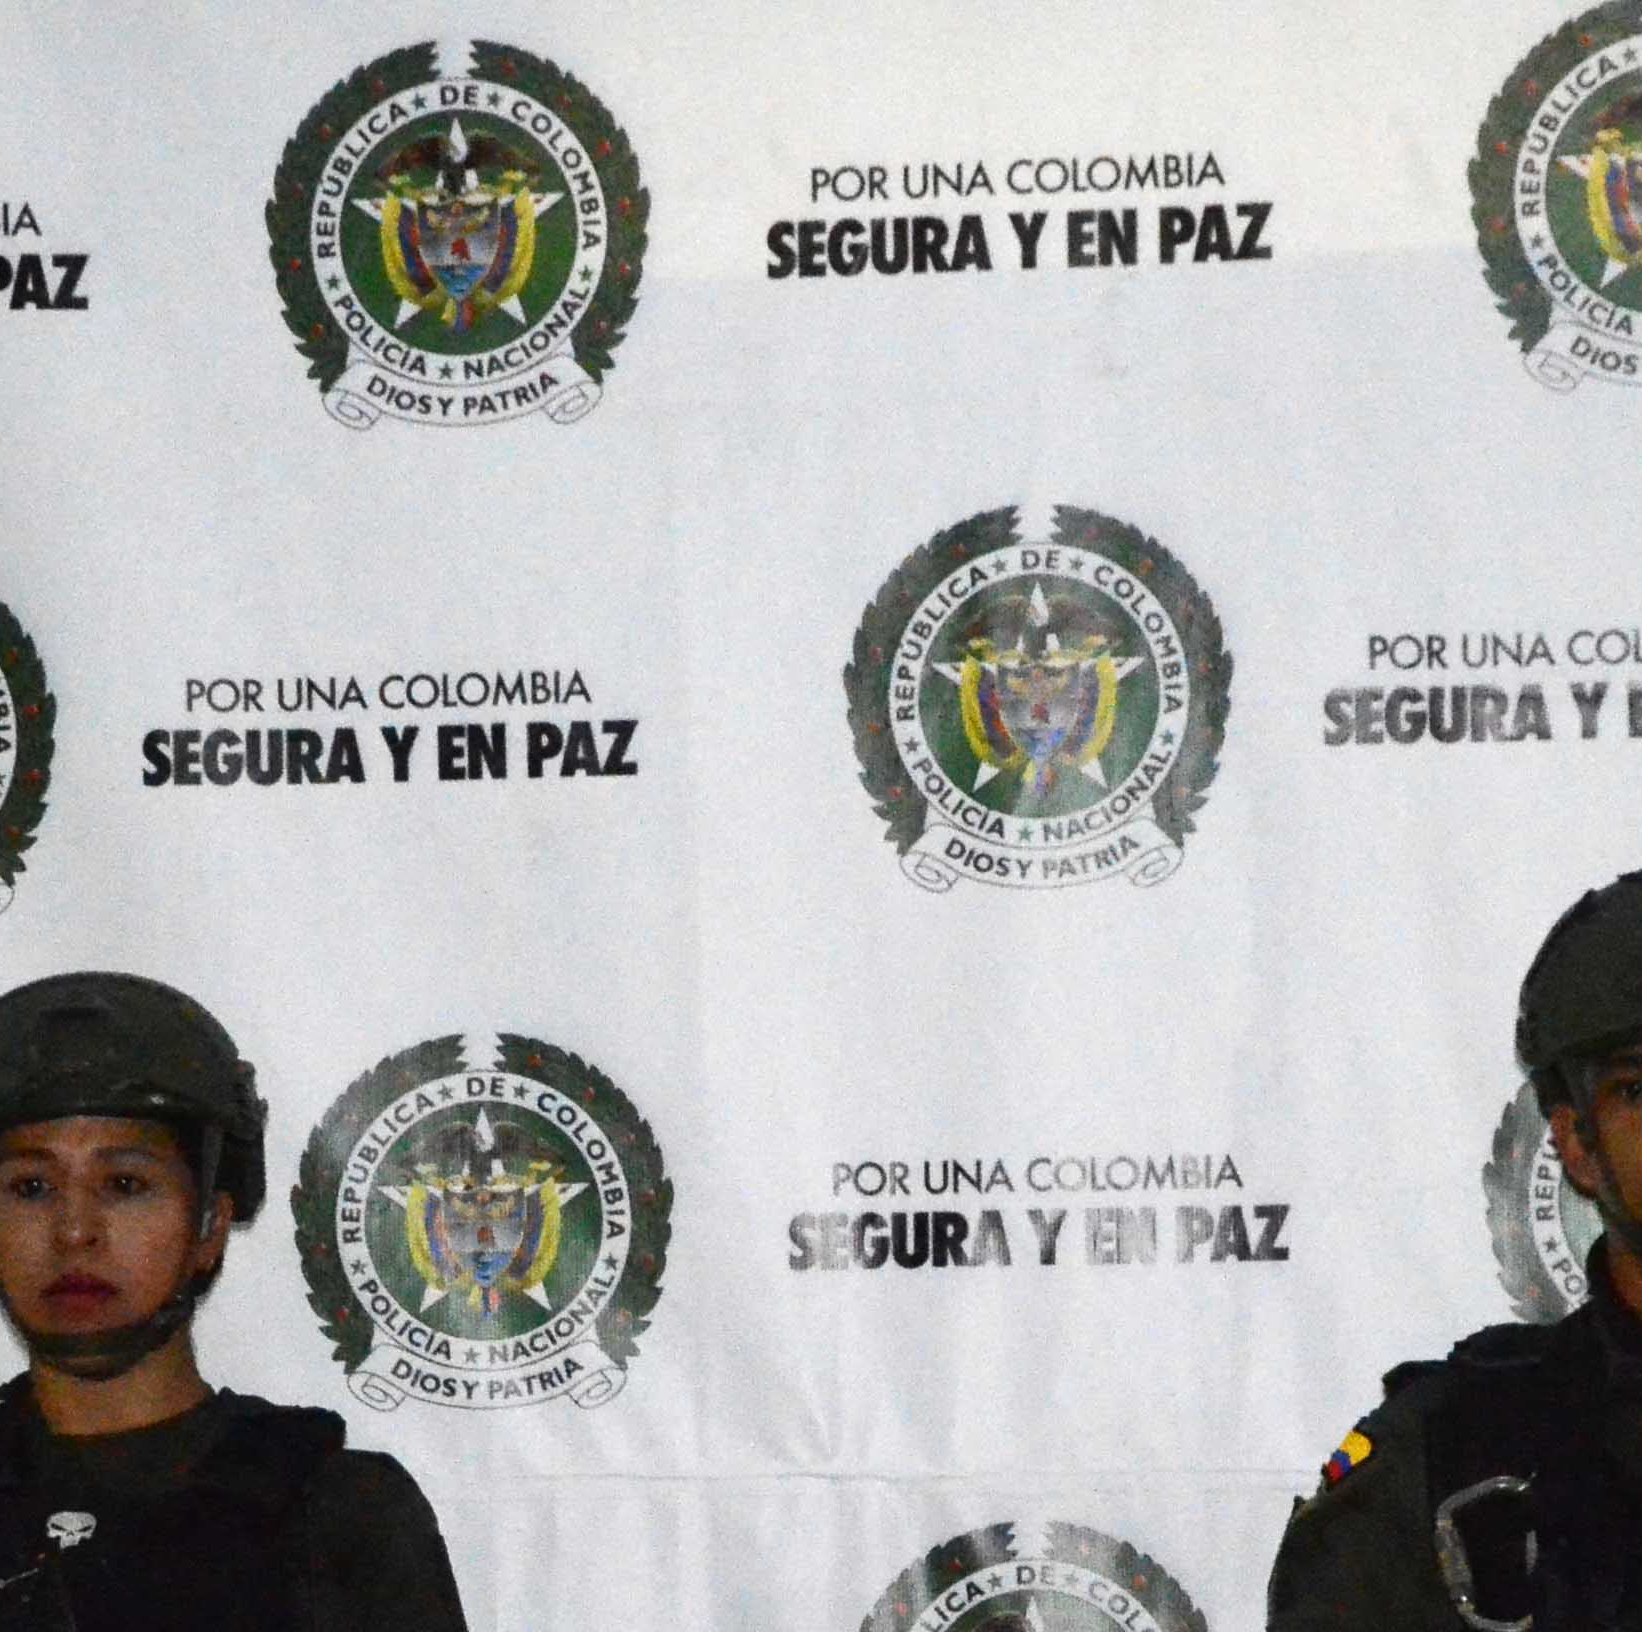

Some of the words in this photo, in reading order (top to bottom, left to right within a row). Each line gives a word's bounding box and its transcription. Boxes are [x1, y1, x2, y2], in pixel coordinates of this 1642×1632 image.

[810, 165, 889, 203] POR
[902, 161, 995, 200] UNA
[1006, 152, 1226, 195] COLOMBIA
[766, 213, 993, 281] SEGURA
[1008, 210, 1048, 271] Y
[1066, 207, 1139, 269] EN
[1158, 201, 1273, 266] PAZ
[1368, 634, 1448, 670] POR
[1461, 633, 1556, 668] UNA
[185, 678, 264, 713] POR
[277, 676, 369, 713] UNA
[378, 669, 592, 710] COLOMBIA
[1323, 684, 1553, 746] SEGURA
[1570, 681, 1609, 740] Y
[141, 726, 367, 788] SEGURA
[380, 724, 421, 783] Y
[436, 721, 508, 782] EN
[525, 718, 639, 780] PAZ
[465, 1076, 506, 1098] DE
[537, 1091, 626, 1240] COLOMBIA
[834, 1160, 911, 1197] POR
[923, 1159, 1014, 1196] UNA
[1026, 1155, 1244, 1192] COLOMBIA
[788, 1208, 1012, 1271] SEGURA
[1027, 1209, 1067, 1267] Y
[1089, 1207, 1158, 1266] EN
[1179, 1203, 1291, 1263] PAZ
[489, 1273, 617, 1362] NACIONAL
[488, 1357, 585, 1400] PATRIA
